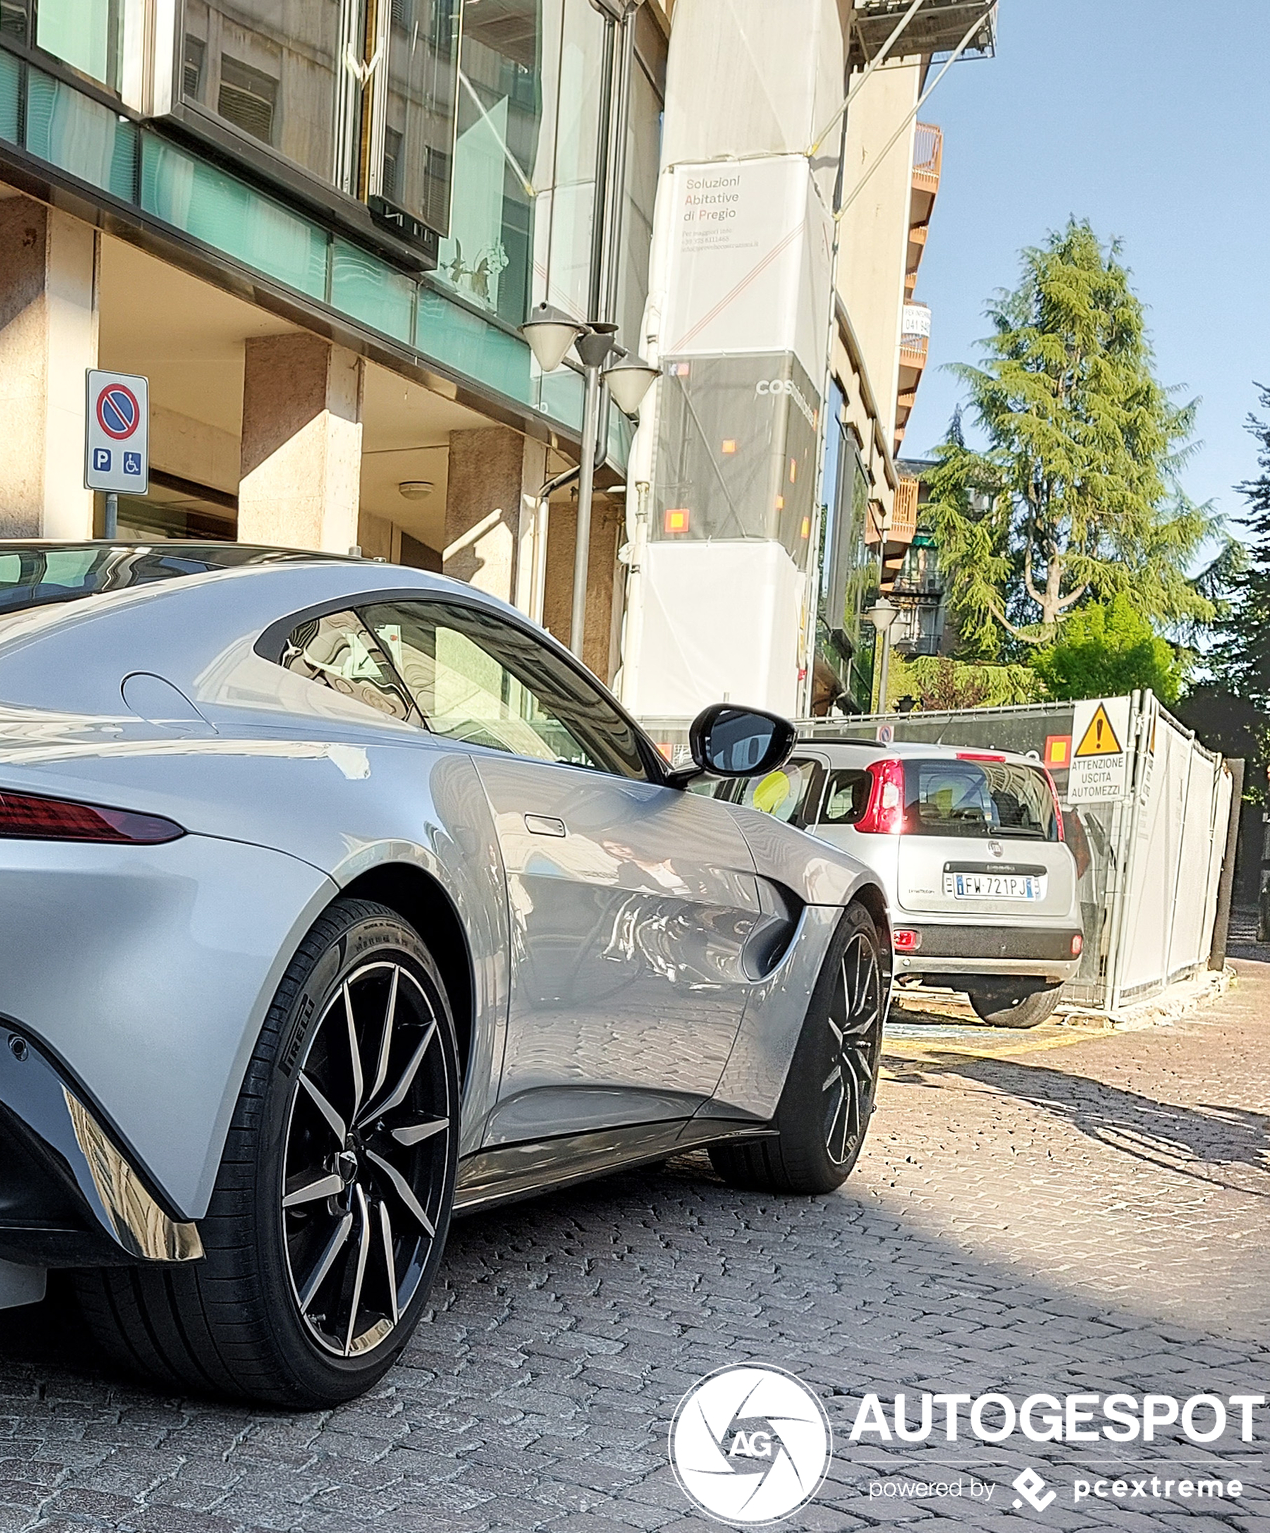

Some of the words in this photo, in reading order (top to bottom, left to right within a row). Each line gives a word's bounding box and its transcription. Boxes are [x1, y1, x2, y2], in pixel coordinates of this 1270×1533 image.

[686, 175, 740, 190] Soluzioni
[685, 192, 739, 206] Abitative
[683, 211, 695, 222] di
[699, 208, 737, 221] Pregio
[97, 450, 109, 469] P
[1072, 757, 1123, 771] ATTENZIONE
[1081, 772, 1112, 784] USCITA
[1071, 785, 1121, 798] AUTOMEZZI
[986, 878, 1026, 896] 721PJ
[277, 992, 316, 1078] PIRELLI
